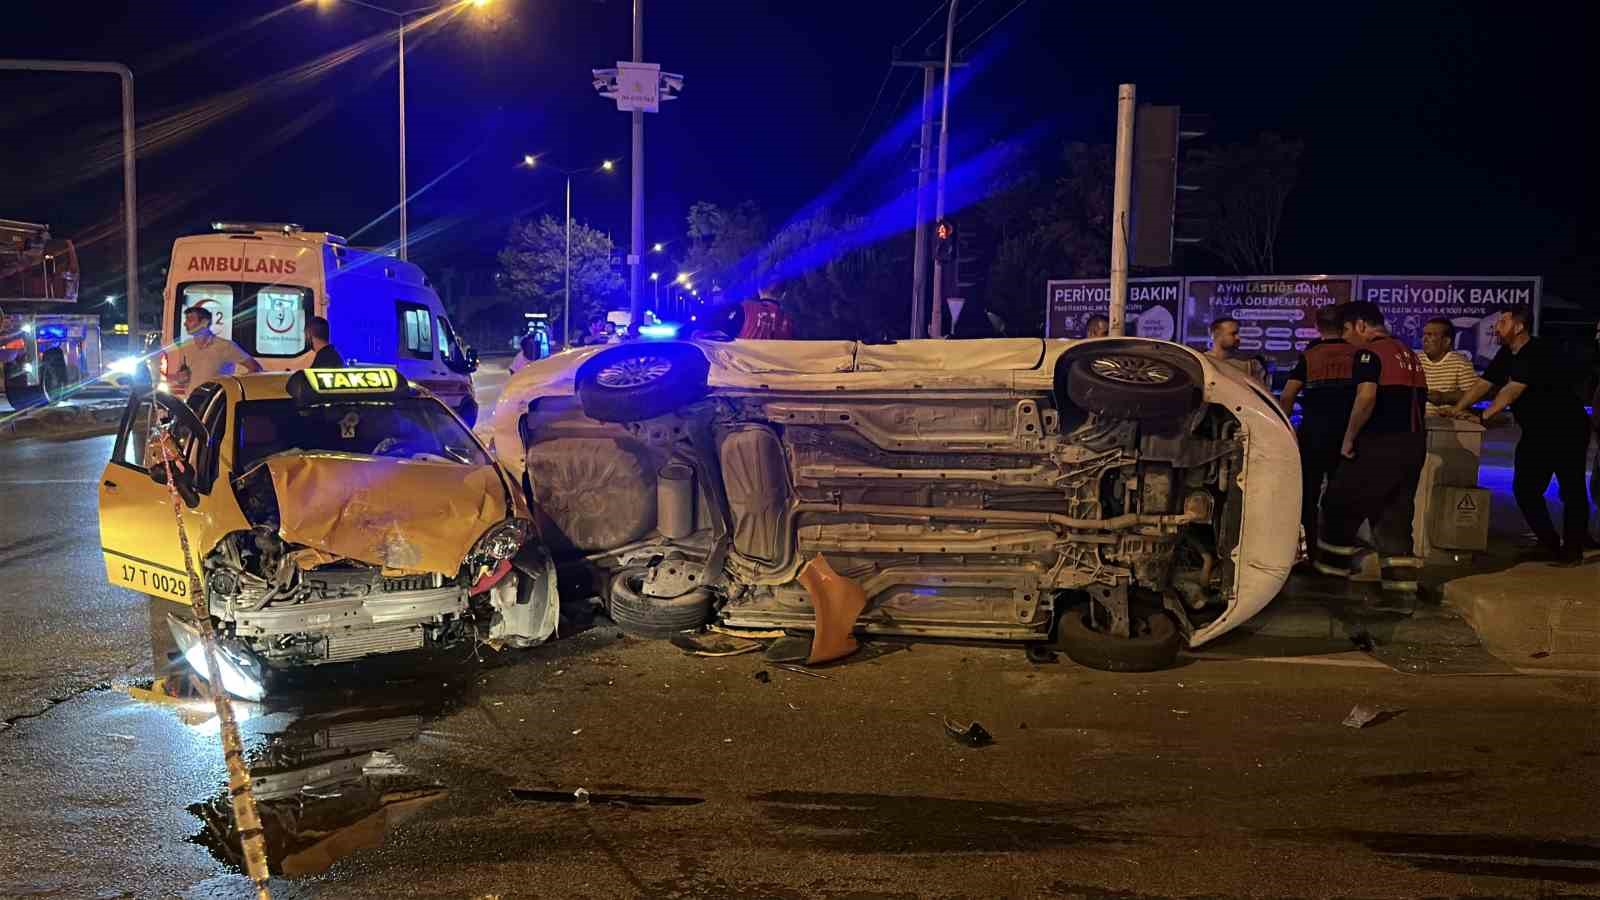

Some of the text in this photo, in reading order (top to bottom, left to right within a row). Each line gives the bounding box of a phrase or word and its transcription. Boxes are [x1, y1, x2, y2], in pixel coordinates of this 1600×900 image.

[187, 256, 297, 274] AMBULANS
[1055, 285, 1177, 302] PERİYOD BAKIM
[1216, 283, 1244, 293] AYNI
[1295, 282, 1329, 293] DAHA
[1366, 284, 1530, 304] PERİYODİK BAKIM
[1208, 295, 1336, 309] FAZLA ÖDEMEMEK İÇİN
[215, 311, 224, 326] 2
[122, 564, 187, 597] 17 T 0029
